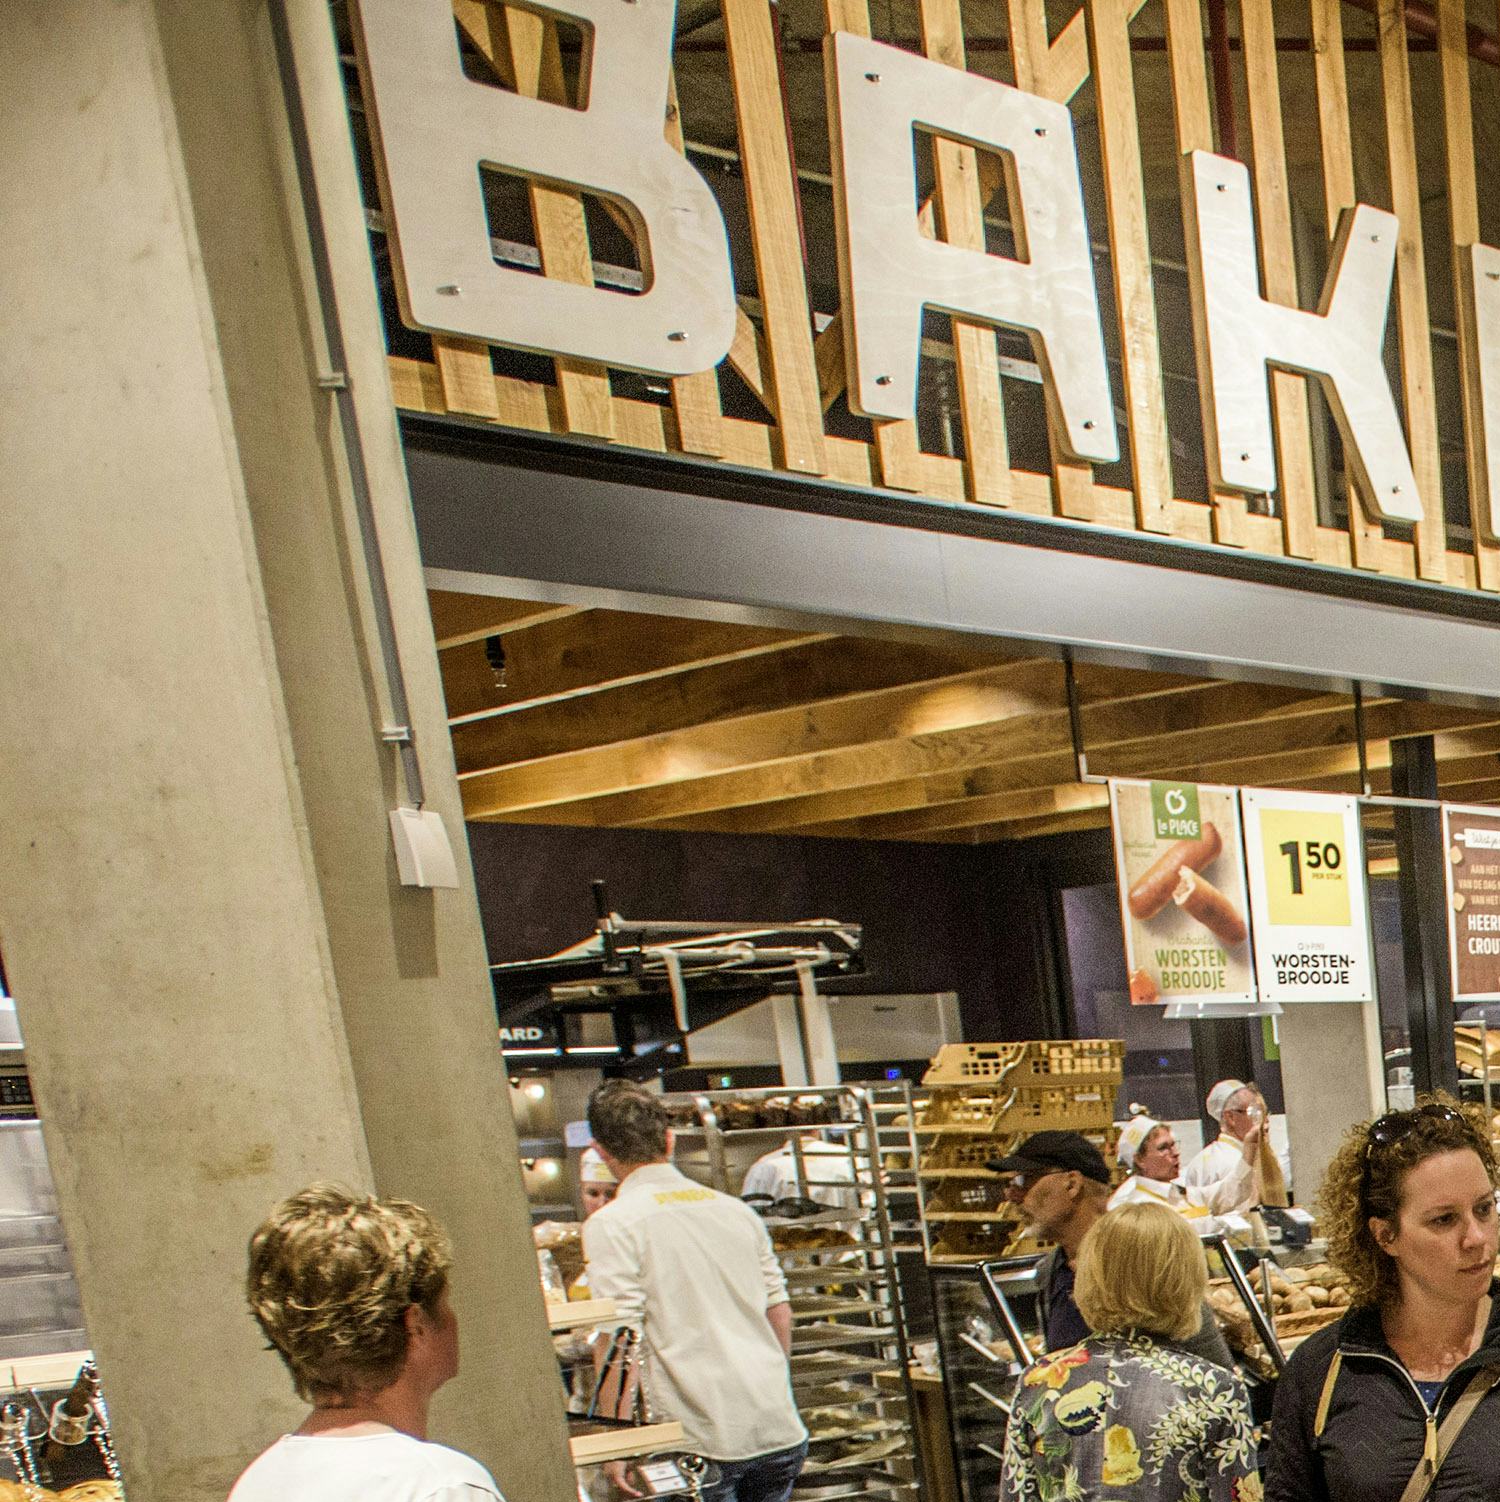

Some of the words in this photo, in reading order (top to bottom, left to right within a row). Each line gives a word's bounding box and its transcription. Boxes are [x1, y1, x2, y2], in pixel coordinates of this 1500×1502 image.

[1168, 819, 1199, 837] PLACE
[1155, 949, 1228, 968] WORSTEN
[1272, 954, 1356, 969] WORSTEN-
[1162, 970, 1227, 991] BROODJE
[1277, 971, 1351, 985] BROODJE
